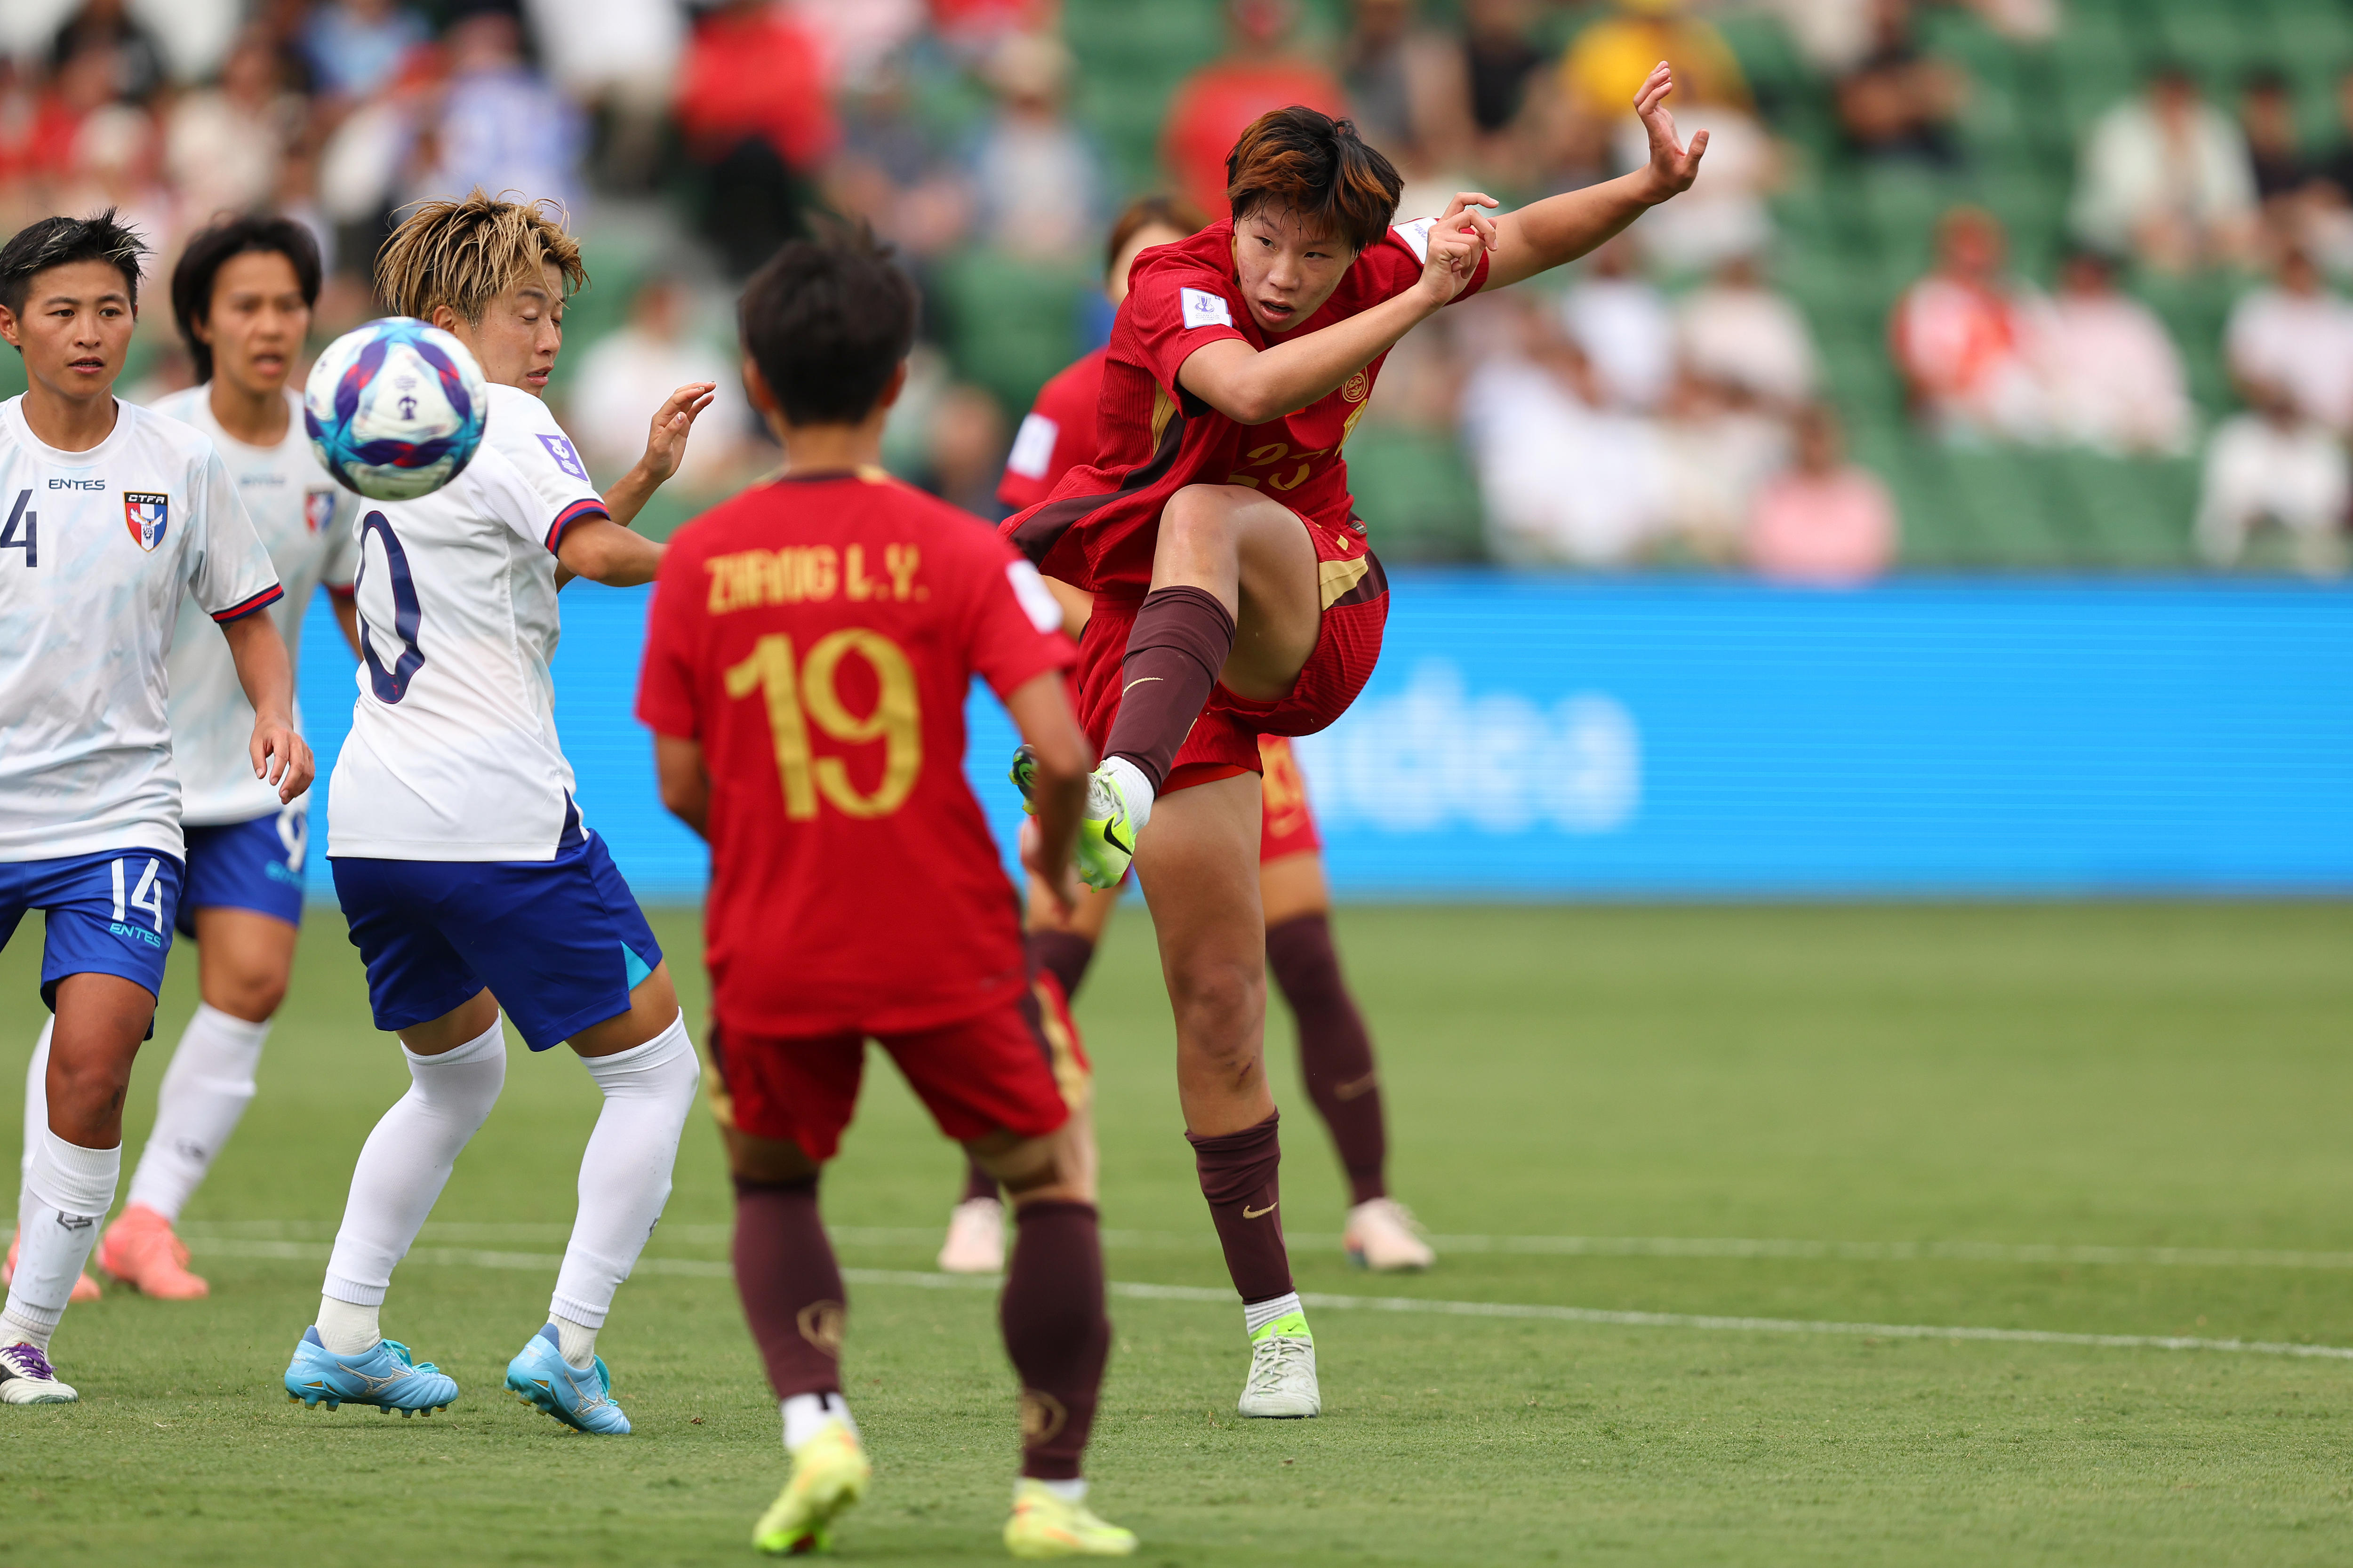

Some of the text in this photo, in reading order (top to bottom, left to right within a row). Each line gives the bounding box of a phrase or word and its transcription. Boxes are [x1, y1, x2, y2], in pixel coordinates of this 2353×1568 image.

[48, 478, 105, 490] ENTES
[128, 494, 165, 504] CTFA
[0, 489, 37, 567] 4
[354, 510, 425, 704] 0
[846, 543, 929, 603] L.Y.
[724, 626, 923, 822] 19
[112, 857, 162, 934] 14
[109, 922, 161, 949] ENTES
